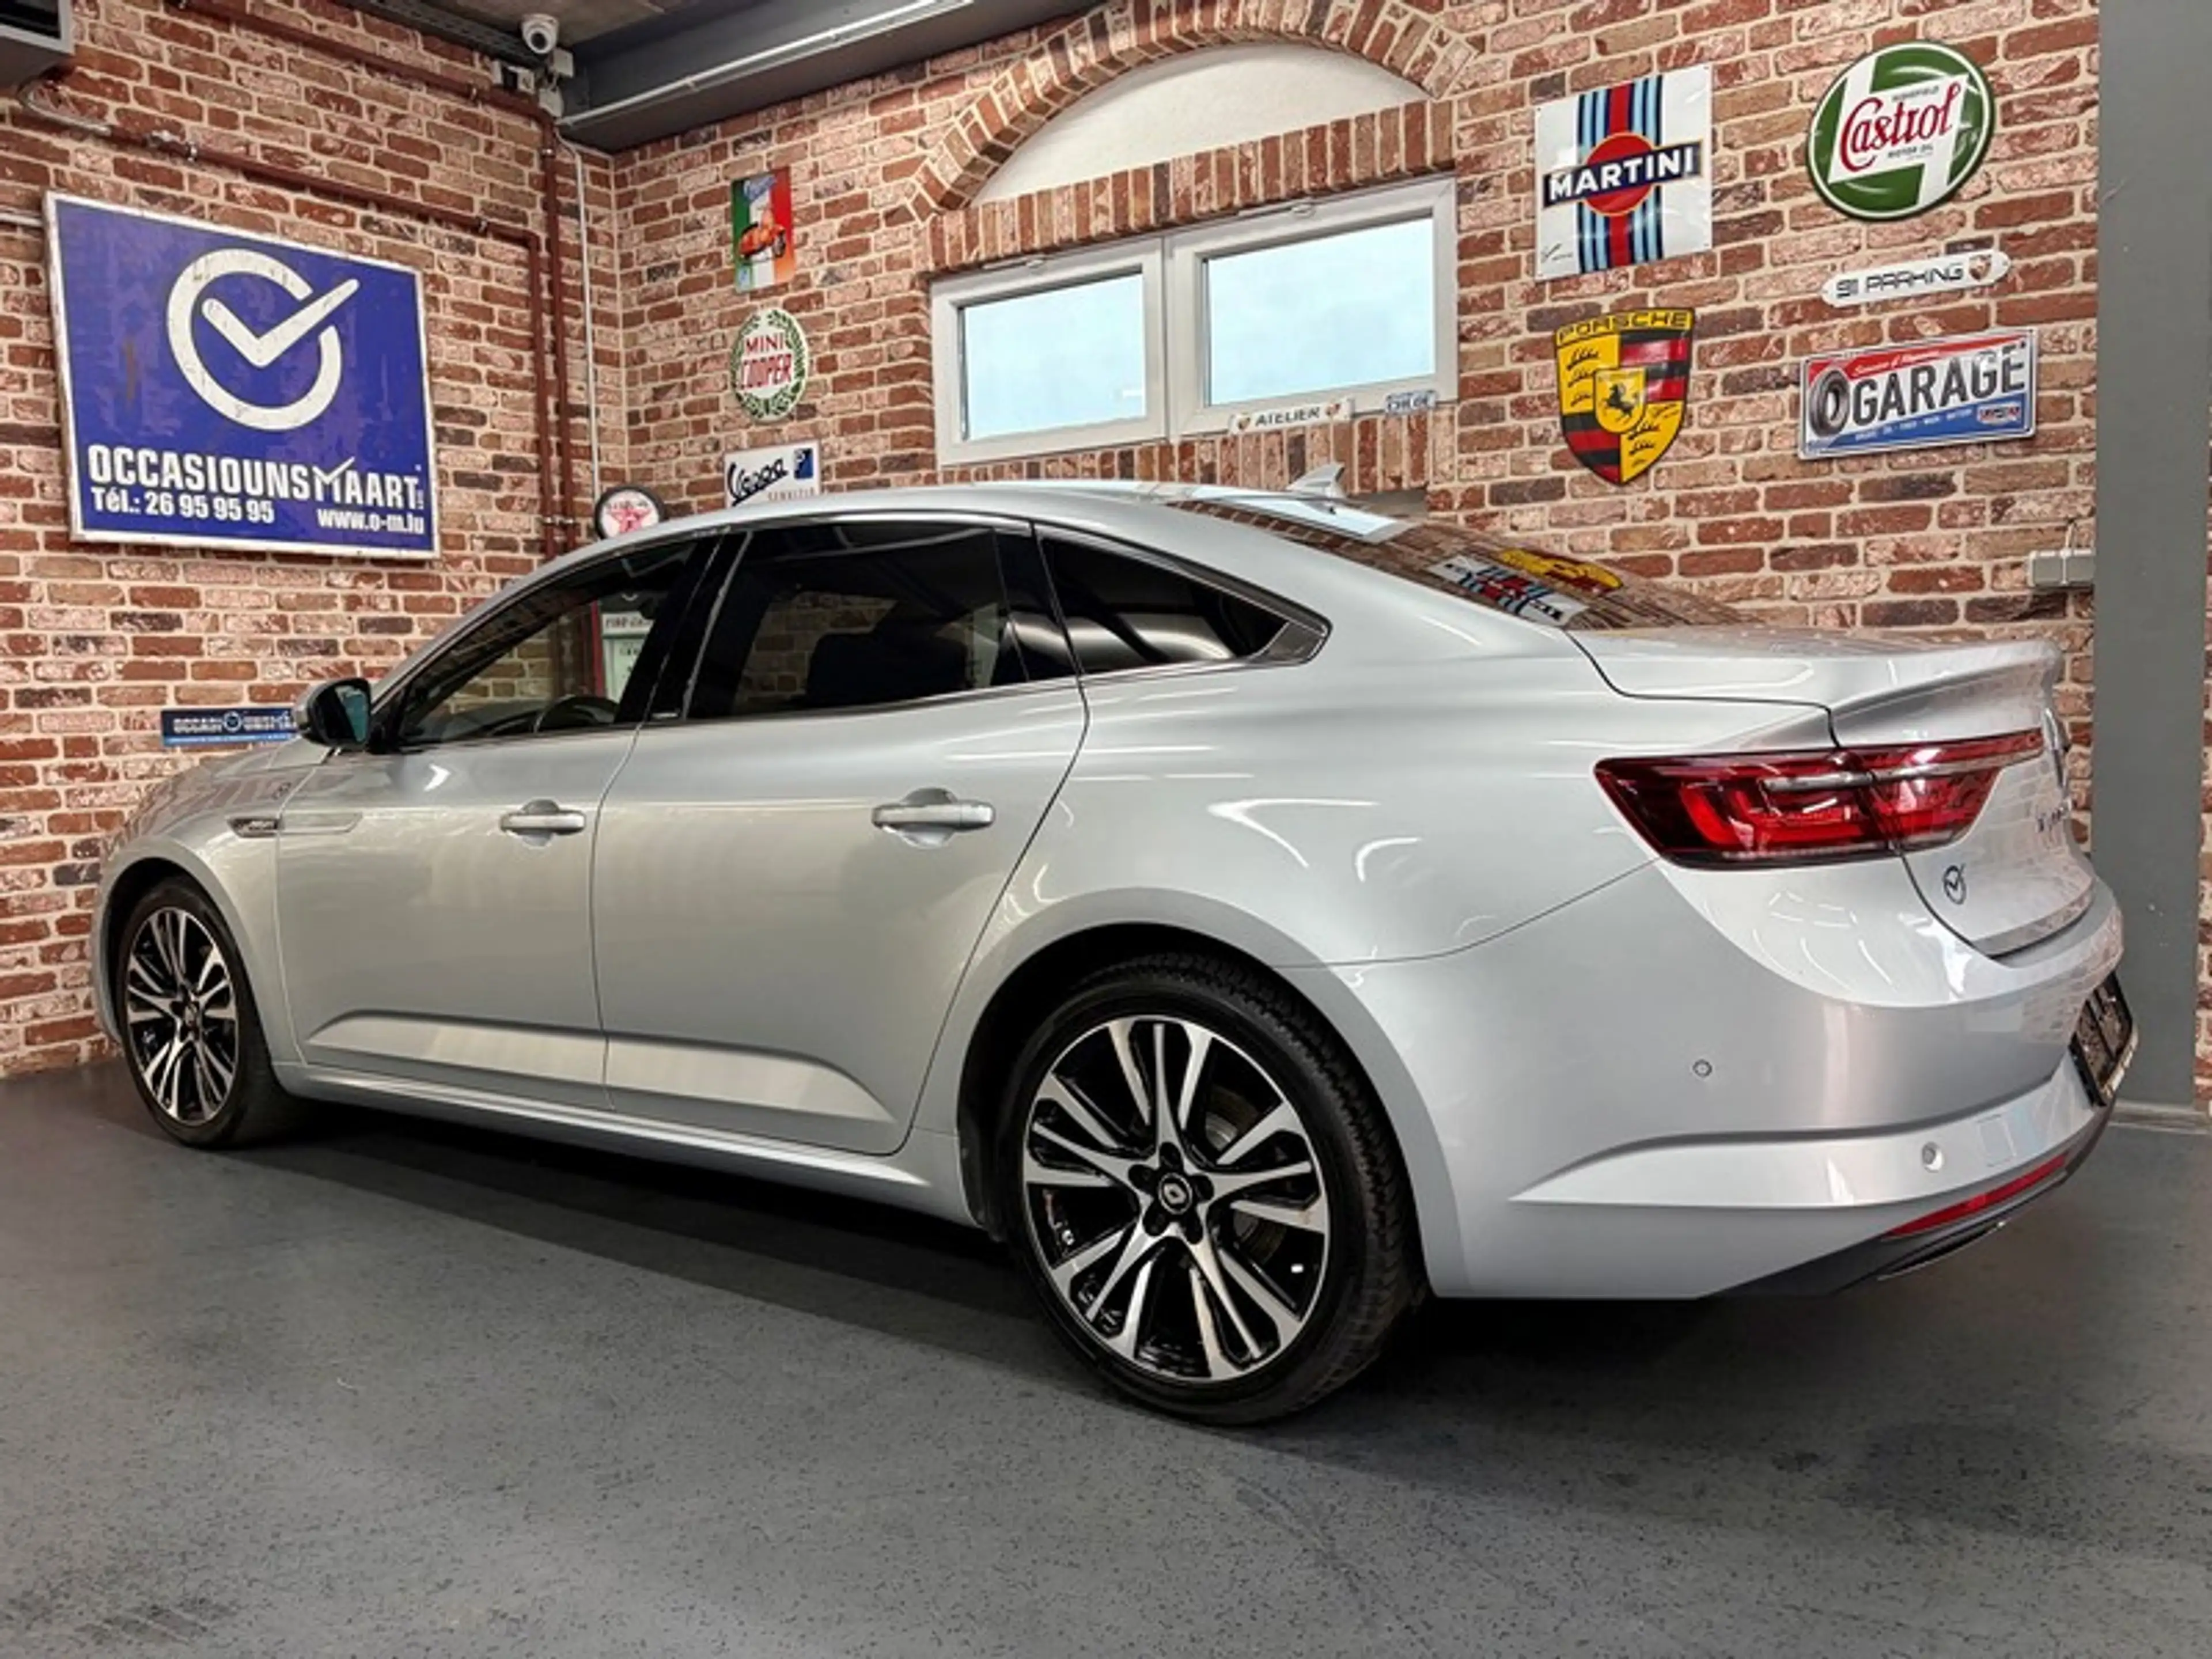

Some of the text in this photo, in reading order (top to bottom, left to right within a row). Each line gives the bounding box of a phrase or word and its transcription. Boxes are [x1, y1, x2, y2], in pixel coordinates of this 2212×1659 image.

[1839, 82, 1961, 172] Castrol
[1549, 146, 1694, 201] MARTINI
[1865, 262, 1964, 294] PARKING
[745, 331, 784, 356] MINI
[1852, 344, 2026, 427] GARAGE
[90, 486, 275, 524] Tél.: 26 95 95 95
[317, 507, 425, 535] www.o-m.lu
